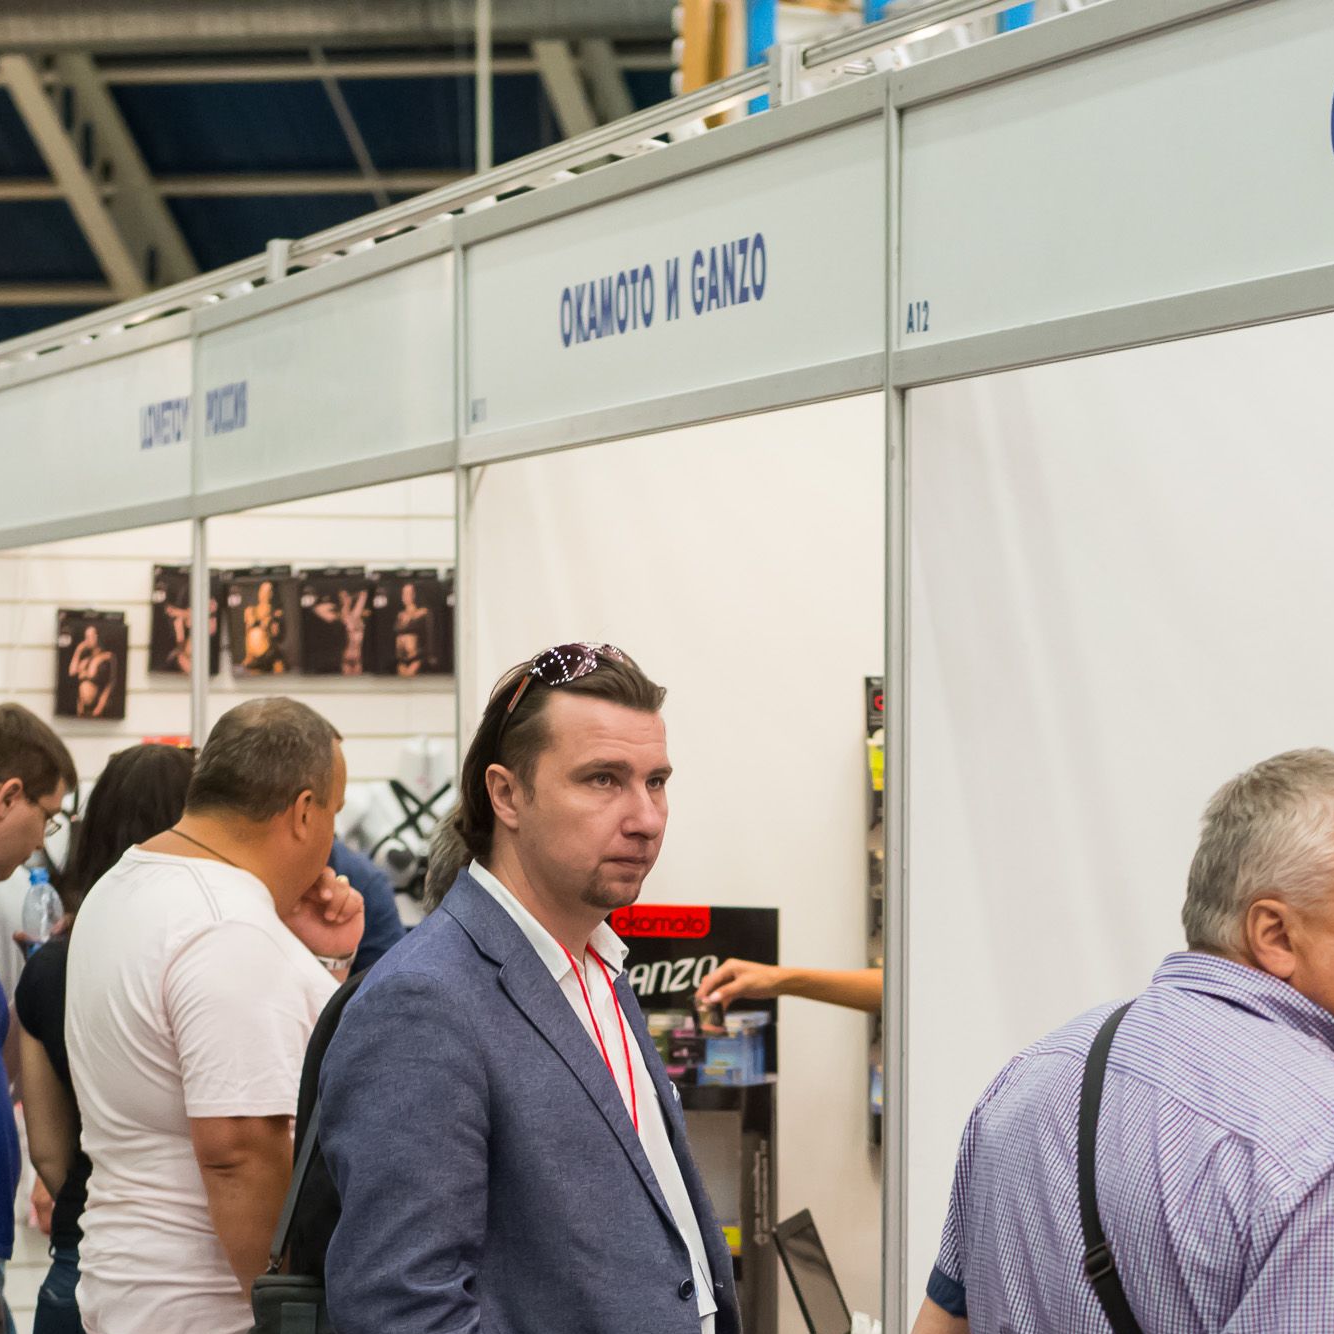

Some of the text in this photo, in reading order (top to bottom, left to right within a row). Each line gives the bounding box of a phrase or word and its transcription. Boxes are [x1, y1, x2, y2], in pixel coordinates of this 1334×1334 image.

[665, 257, 679, 321] И
[691, 232, 766, 316] GANZO
[906, 300, 929, 334] A12
